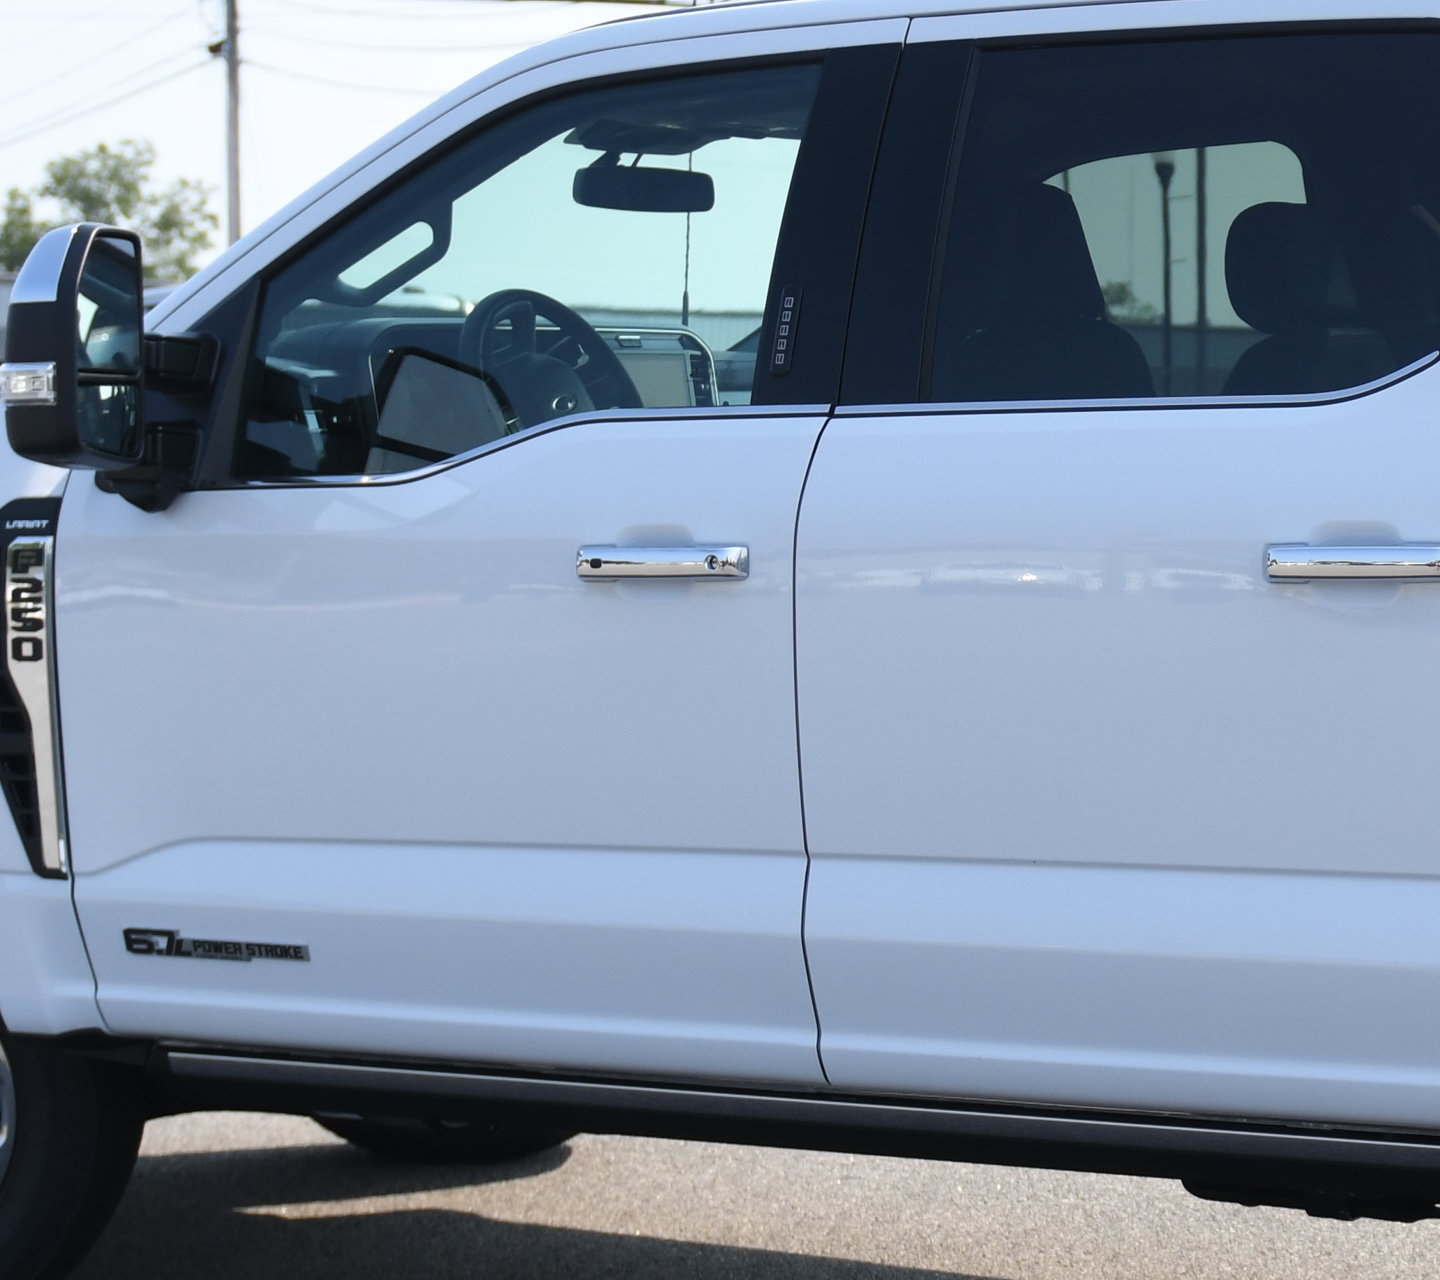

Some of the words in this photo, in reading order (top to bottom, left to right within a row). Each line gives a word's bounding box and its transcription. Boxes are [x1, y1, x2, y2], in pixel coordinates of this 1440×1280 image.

[5, 519, 49, 529] LARIAT
[122, 927, 192, 956] 6.7L
[192, 935, 242, 956] POWER
[246, 939, 304, 960] STROKE
